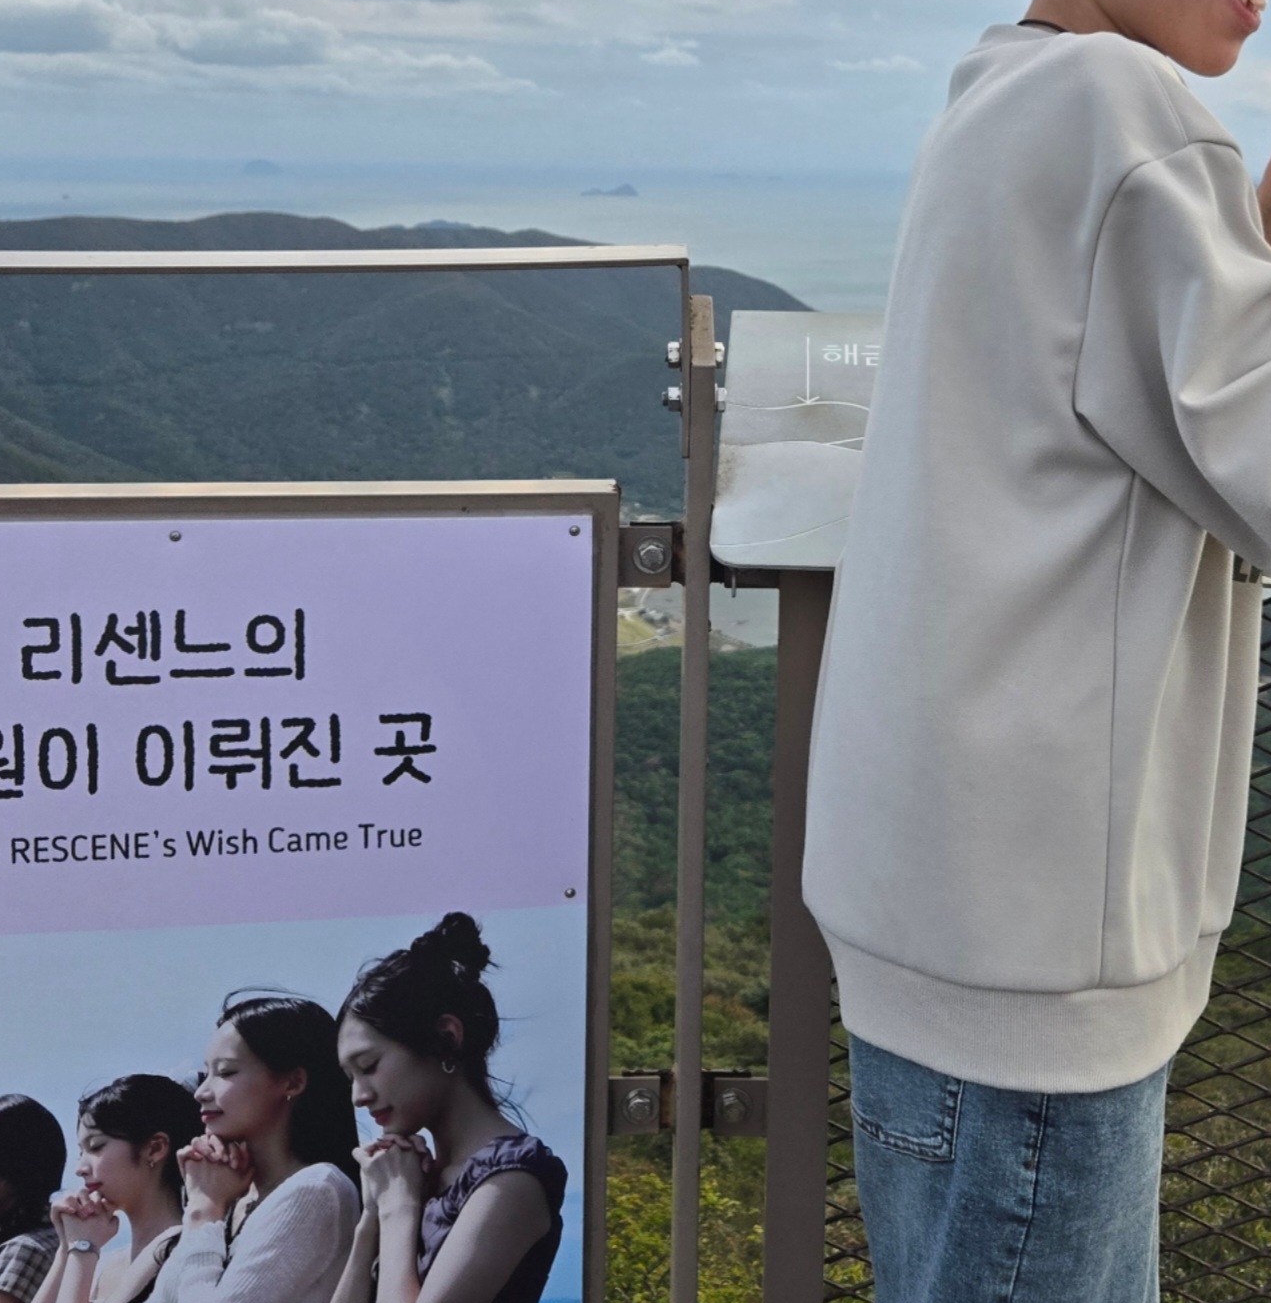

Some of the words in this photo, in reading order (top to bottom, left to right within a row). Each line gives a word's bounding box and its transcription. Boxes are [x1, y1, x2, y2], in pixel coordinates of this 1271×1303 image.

[21, 608, 305, 686] 리센느의
[135, 713, 342, 792] 이뤄진
[374, 713, 437, 786] 곳
[11, 831, 177, 864] RESCENE's
[186, 828, 258, 857] Wish
[268, 827, 348, 853] Came
[358, 823, 422, 849] True
